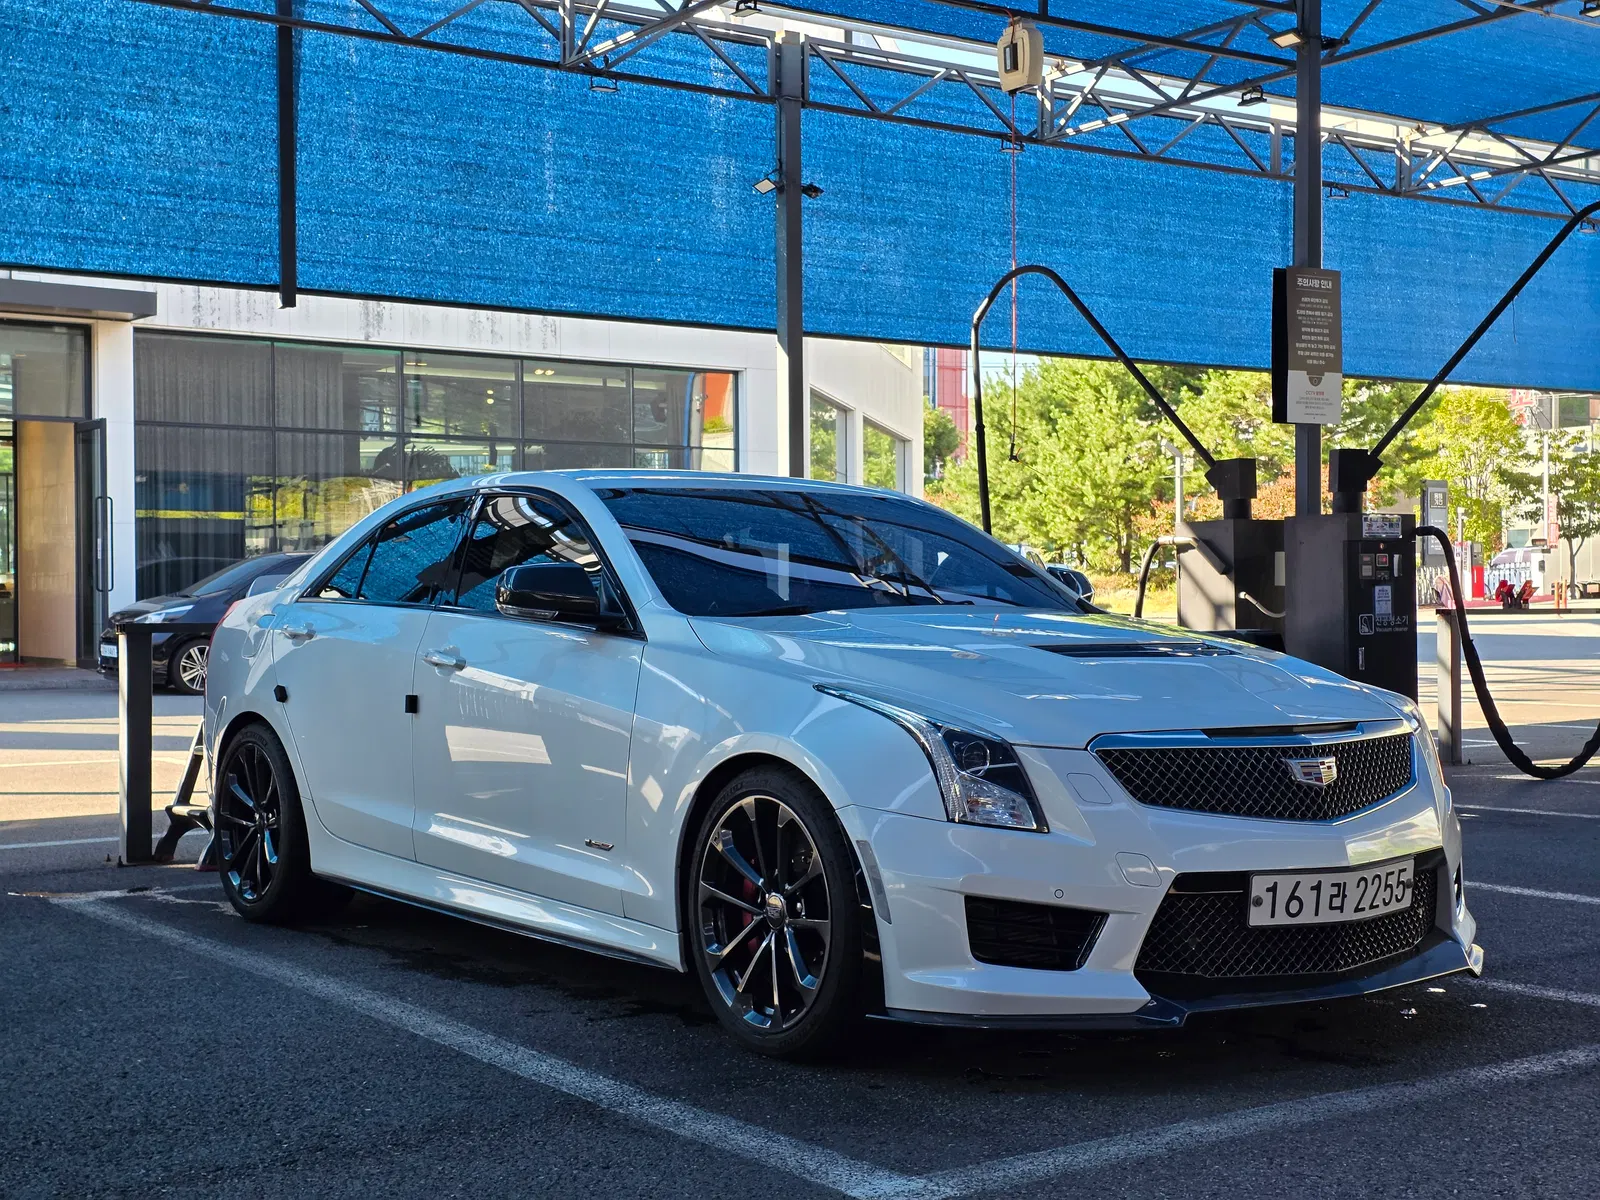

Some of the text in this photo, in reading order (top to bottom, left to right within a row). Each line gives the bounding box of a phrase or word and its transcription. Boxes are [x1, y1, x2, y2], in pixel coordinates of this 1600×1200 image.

[1297, 277, 1332, 289] 주의사항 안내
[1265, 867, 1408, 919] 161라 2255
